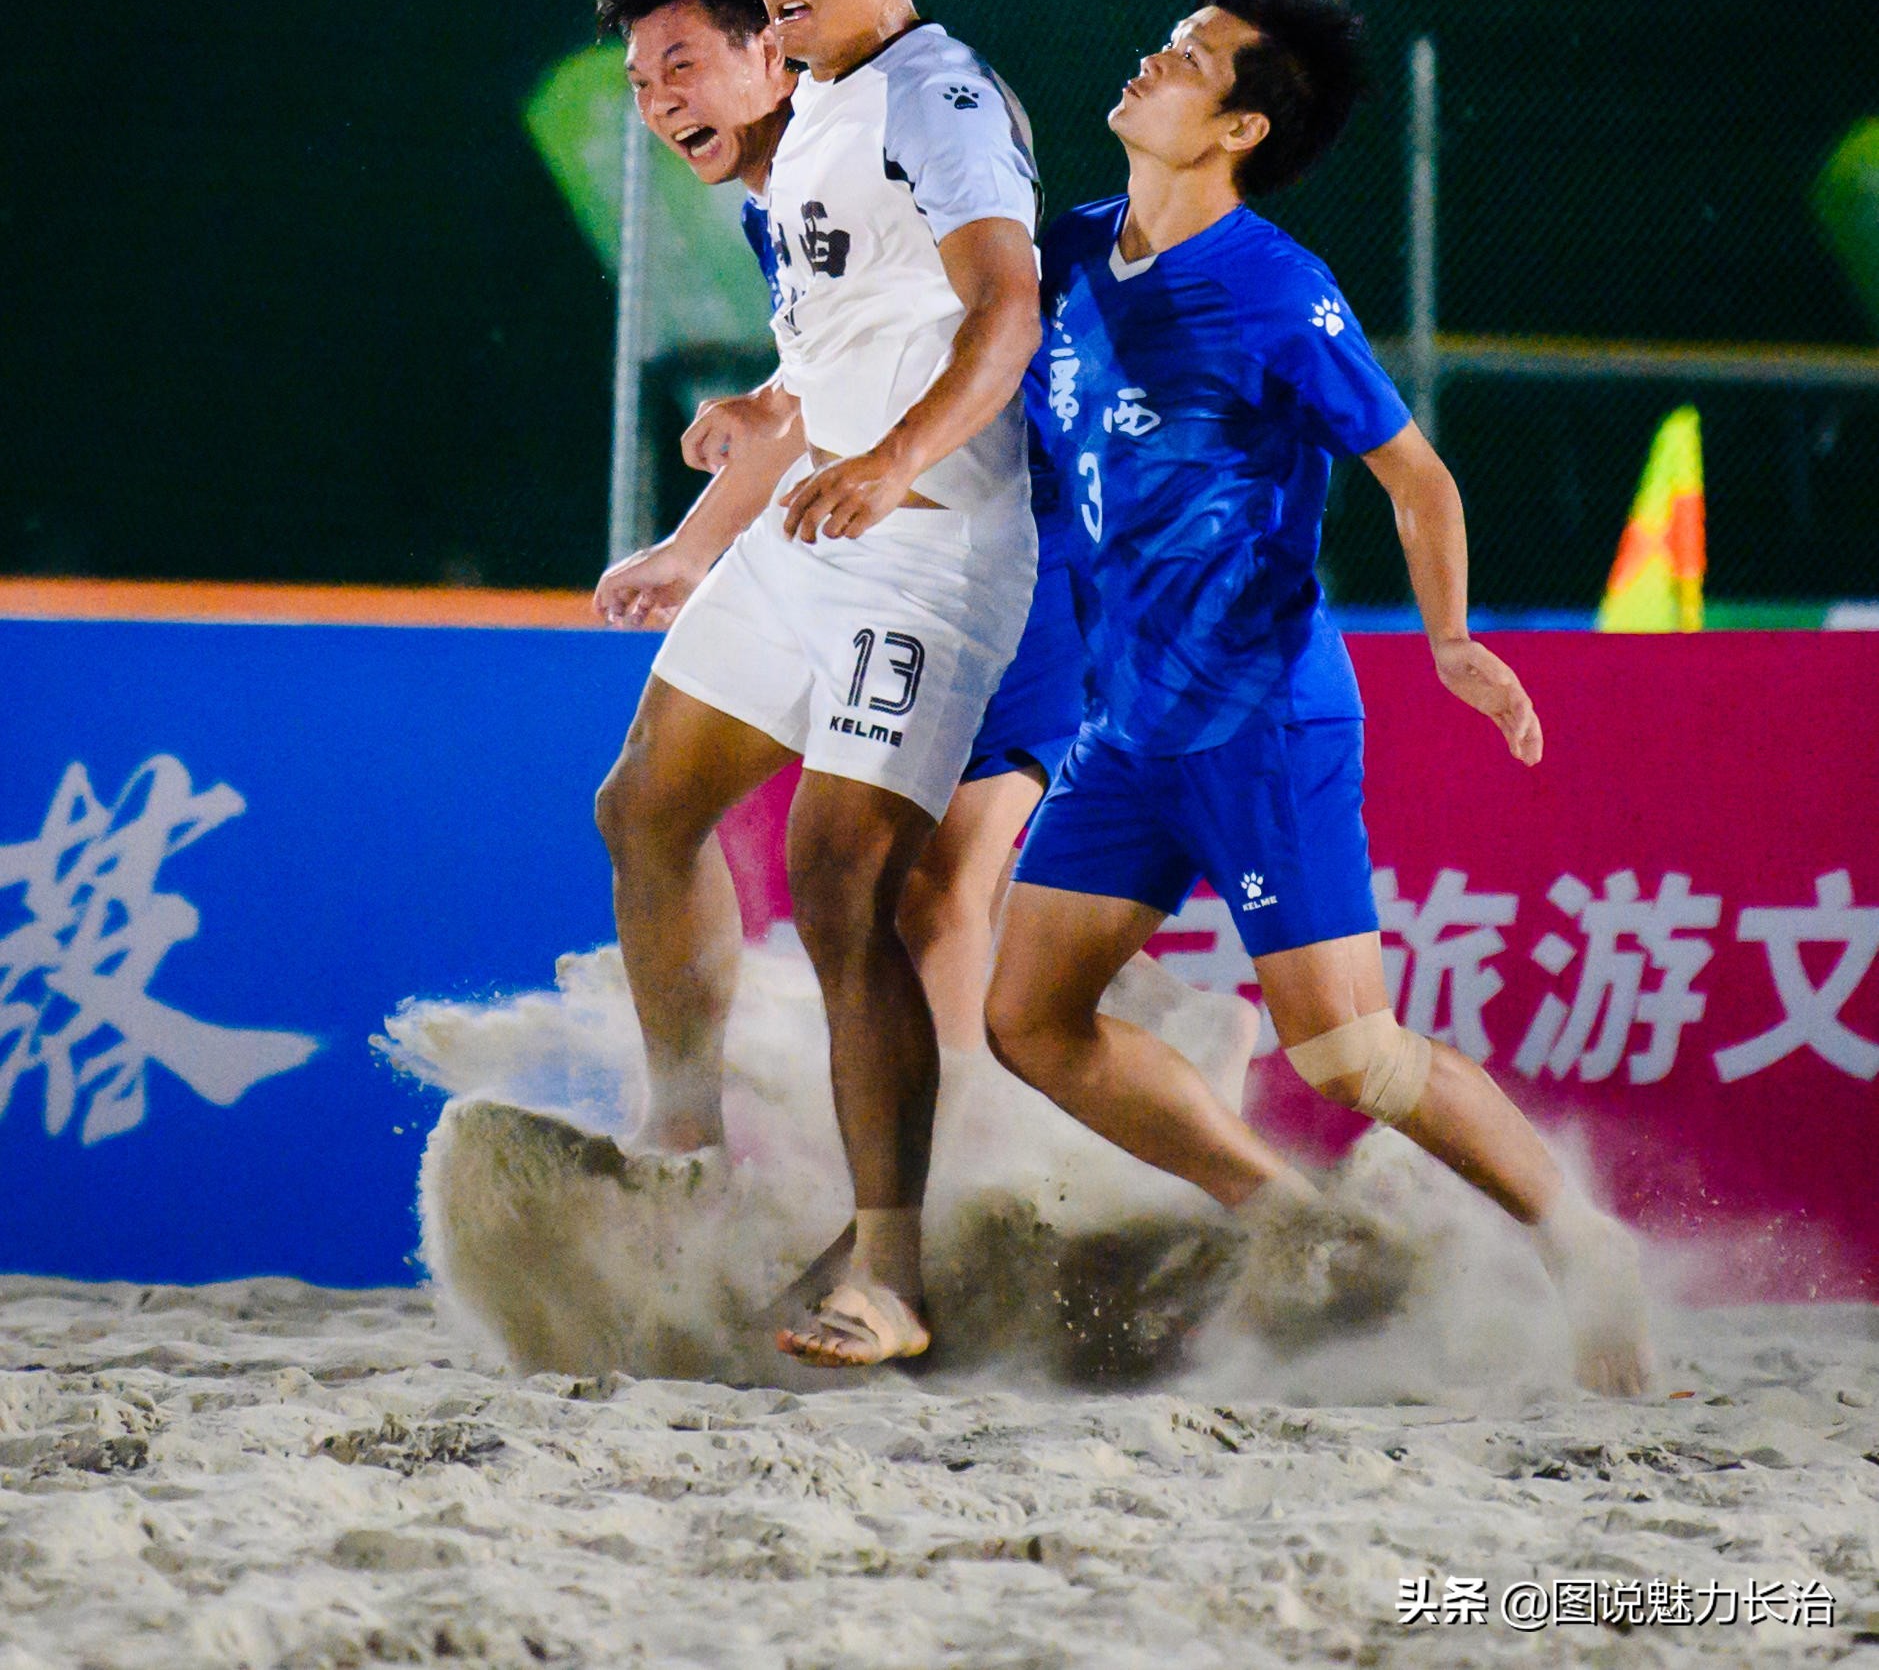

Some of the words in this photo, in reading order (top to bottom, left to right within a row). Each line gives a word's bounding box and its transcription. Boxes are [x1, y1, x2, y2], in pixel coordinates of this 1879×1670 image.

[847, 627, 926, 716] 13
[829, 715, 904, 748] KELME
[1242, 894, 1278, 912] KELME
